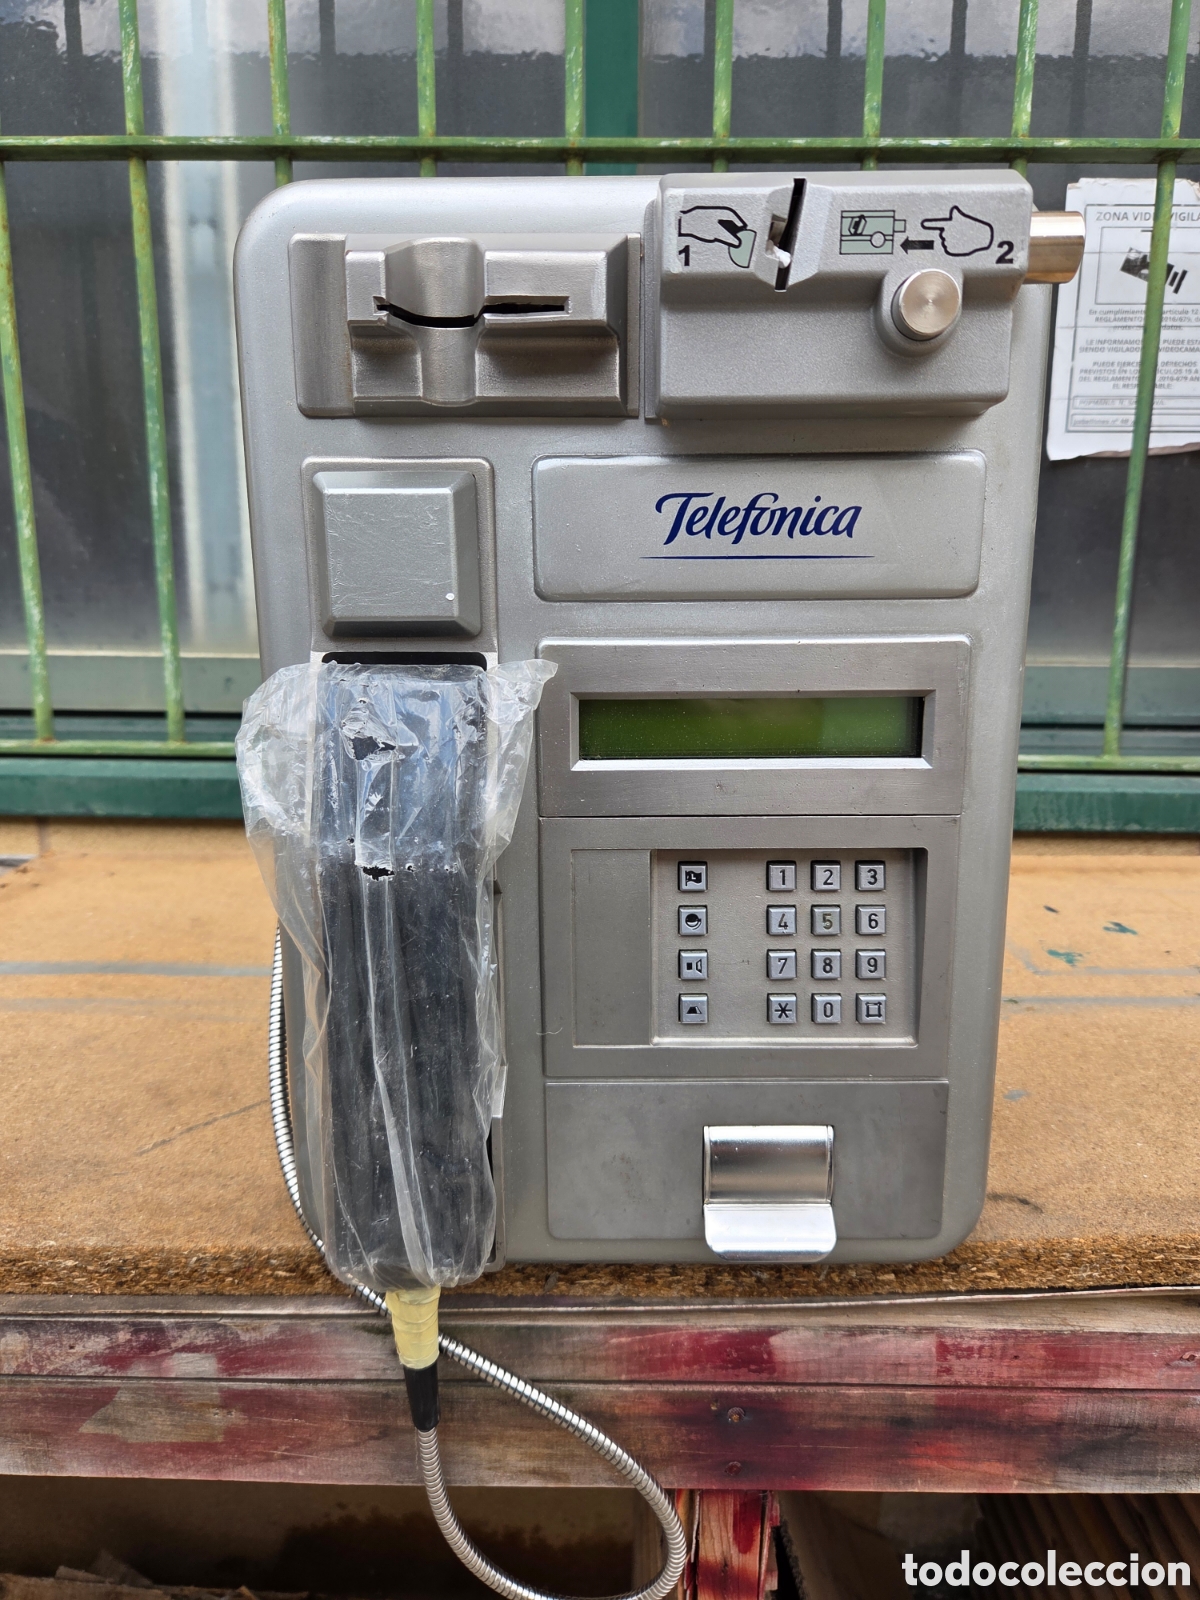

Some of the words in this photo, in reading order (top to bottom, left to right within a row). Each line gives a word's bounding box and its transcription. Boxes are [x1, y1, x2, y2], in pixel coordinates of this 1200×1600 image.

[1096, 211, 1129, 221] ZONA
[678, 246, 691, 266] 1
[995, 241, 1015, 264] 2
[779, 869, 786, 886] 1
[823, 869, 834, 886] 2
[867, 868, 878, 885] 3
[778, 913, 789, 930] 4
[823, 913, 833, 930] 5
[868, 913, 879, 930] 6
[777, 957, 788, 974] 7
[822, 957, 833, 974] 8
[867, 957, 878, 973] 9
[823, 1002, 833, 1018] 0
